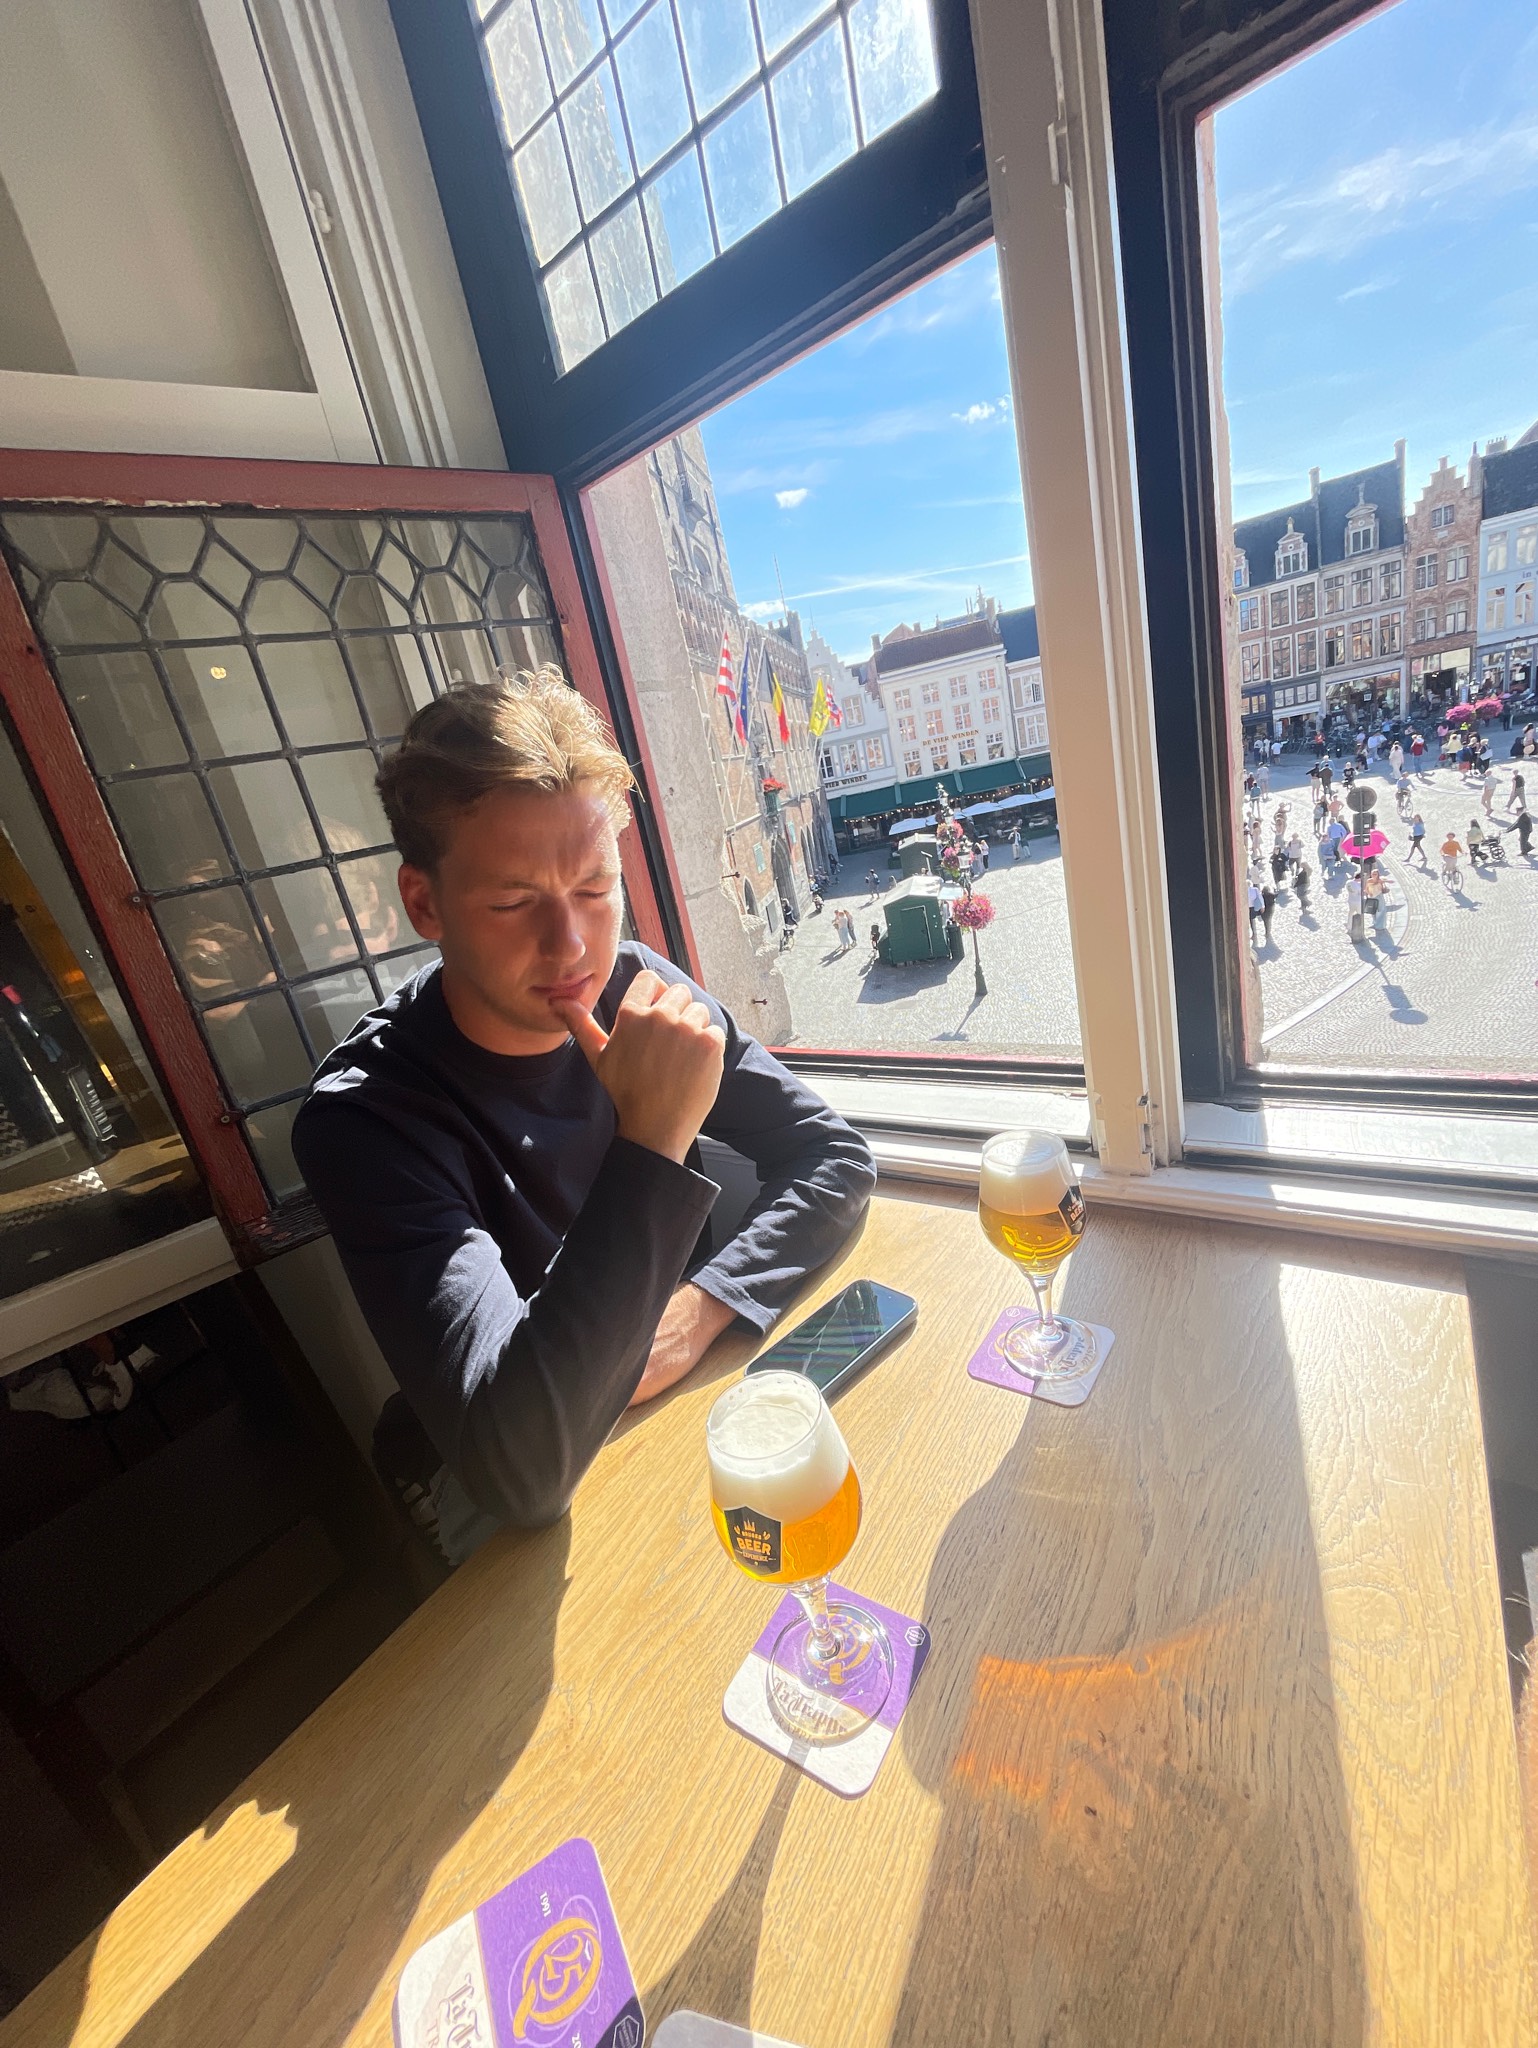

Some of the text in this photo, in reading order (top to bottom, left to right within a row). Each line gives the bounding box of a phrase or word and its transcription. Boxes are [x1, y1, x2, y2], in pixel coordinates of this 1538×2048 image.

[951, 729, 979, 739] WINDEN
[840, 774, 867, 785] WINDEN
[736, 1537, 771, 1555] BEER
[539, 1891, 552, 1917] 1991
